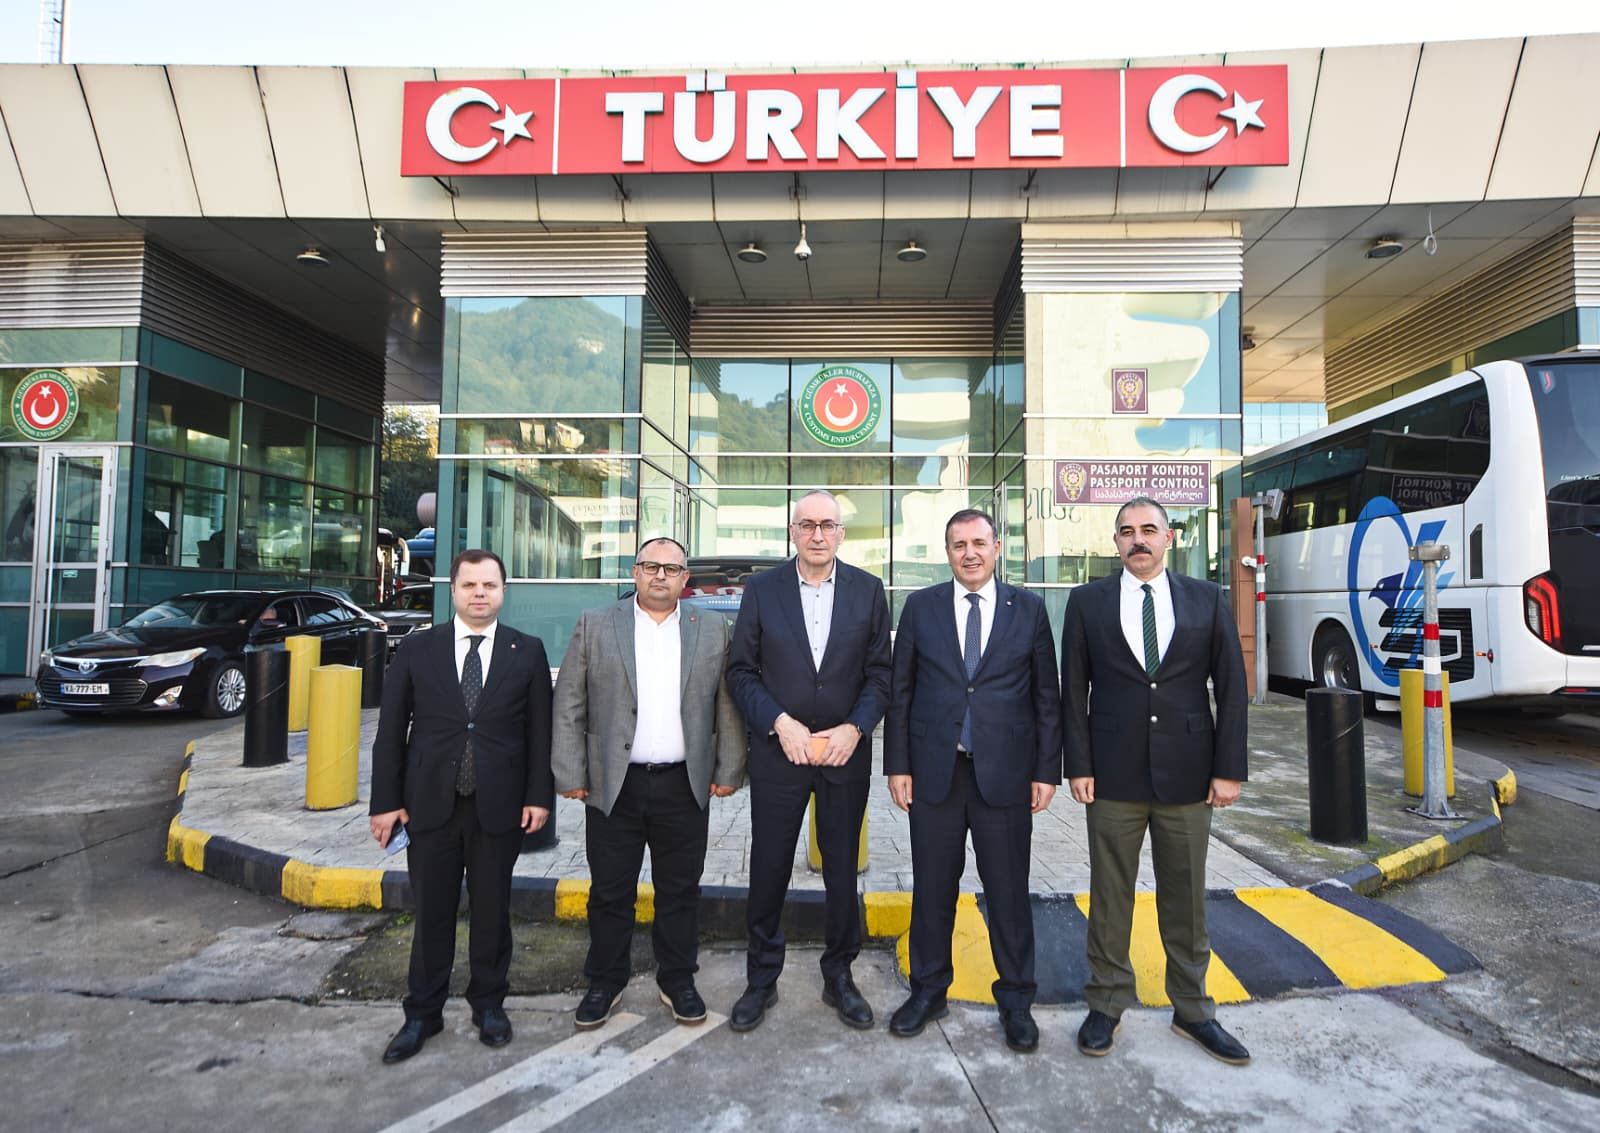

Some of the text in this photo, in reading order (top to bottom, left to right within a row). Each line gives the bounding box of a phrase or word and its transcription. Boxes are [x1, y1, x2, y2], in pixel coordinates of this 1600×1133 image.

[605, 70, 1064, 163] TÜRKİYE
[805, 412, 878, 443] CUSTOMS ENFORCEMENT
[1090, 465, 1148, 475] PASAPORT
[1152, 465, 1204, 476] KONTROL
[1090, 477, 1204, 489] PASSPORT CONTROL
